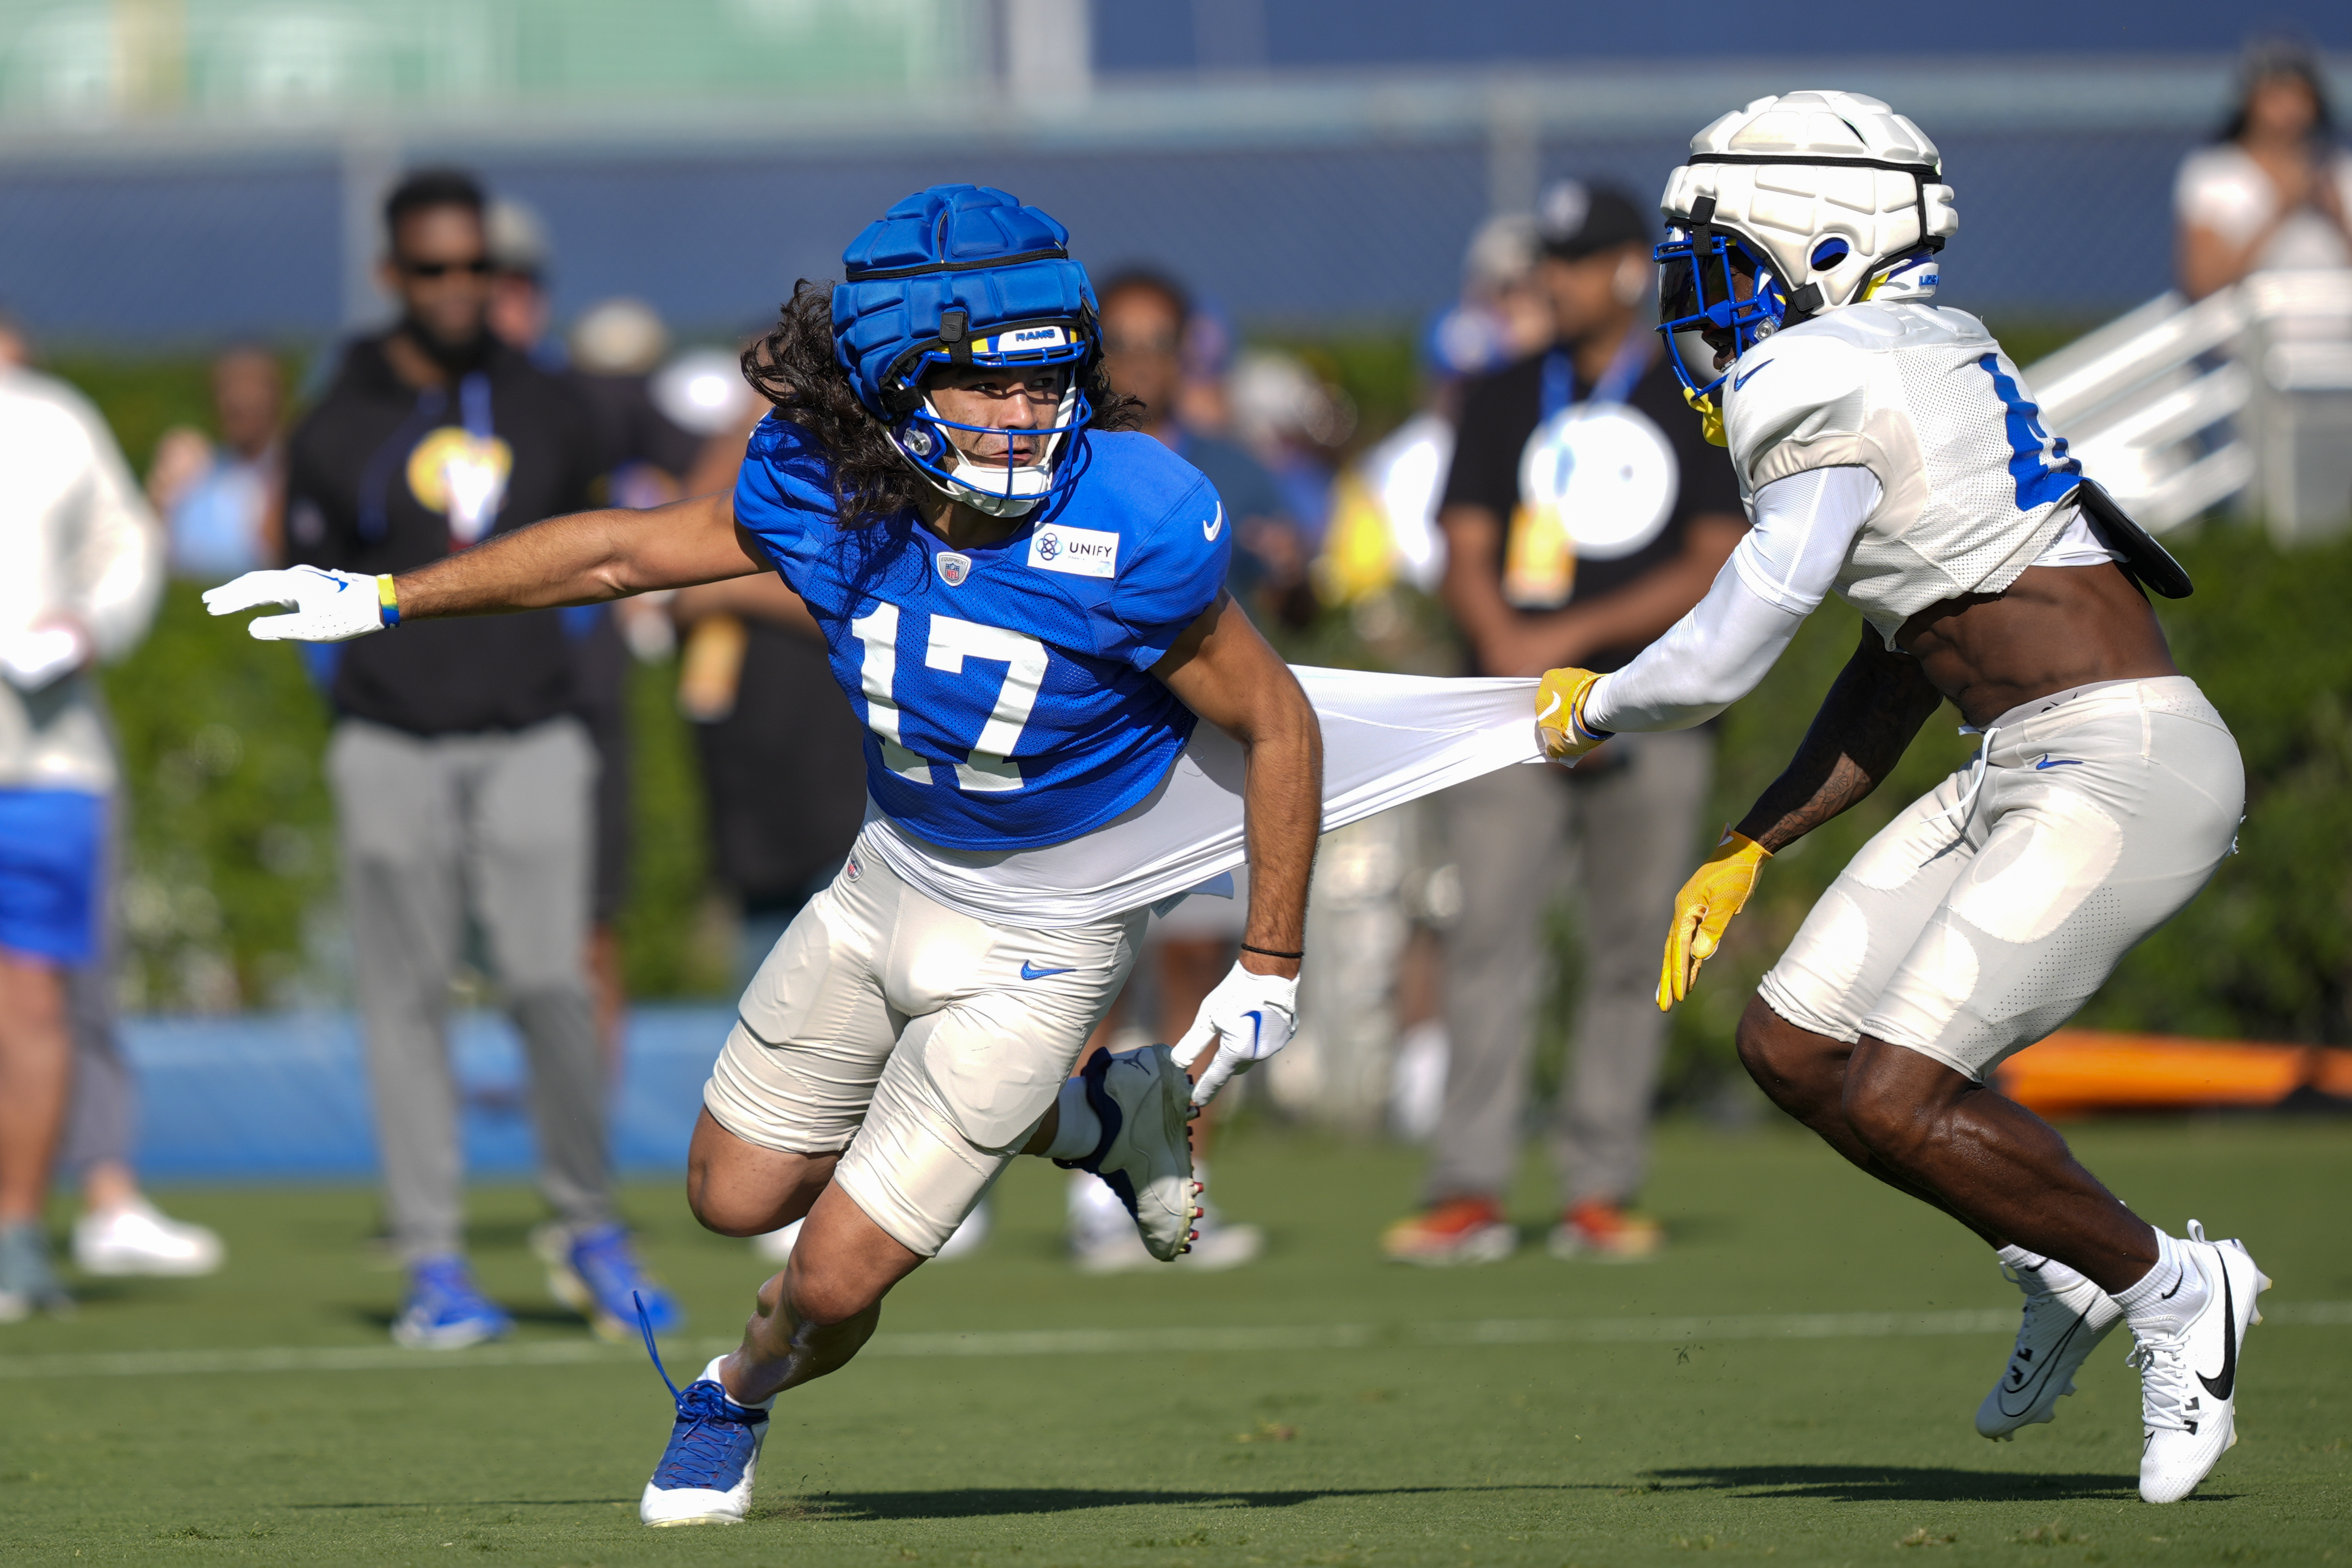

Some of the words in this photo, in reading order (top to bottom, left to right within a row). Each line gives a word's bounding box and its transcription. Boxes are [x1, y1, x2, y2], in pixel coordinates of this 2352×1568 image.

[1015, 329, 1055, 342] RAMS
[1070, 542, 1112, 558] UNIFY
[941, 557, 967, 566] EQUIPMENT
[947, 569, 959, 579] NFL
[851, 601, 1049, 792] 17
